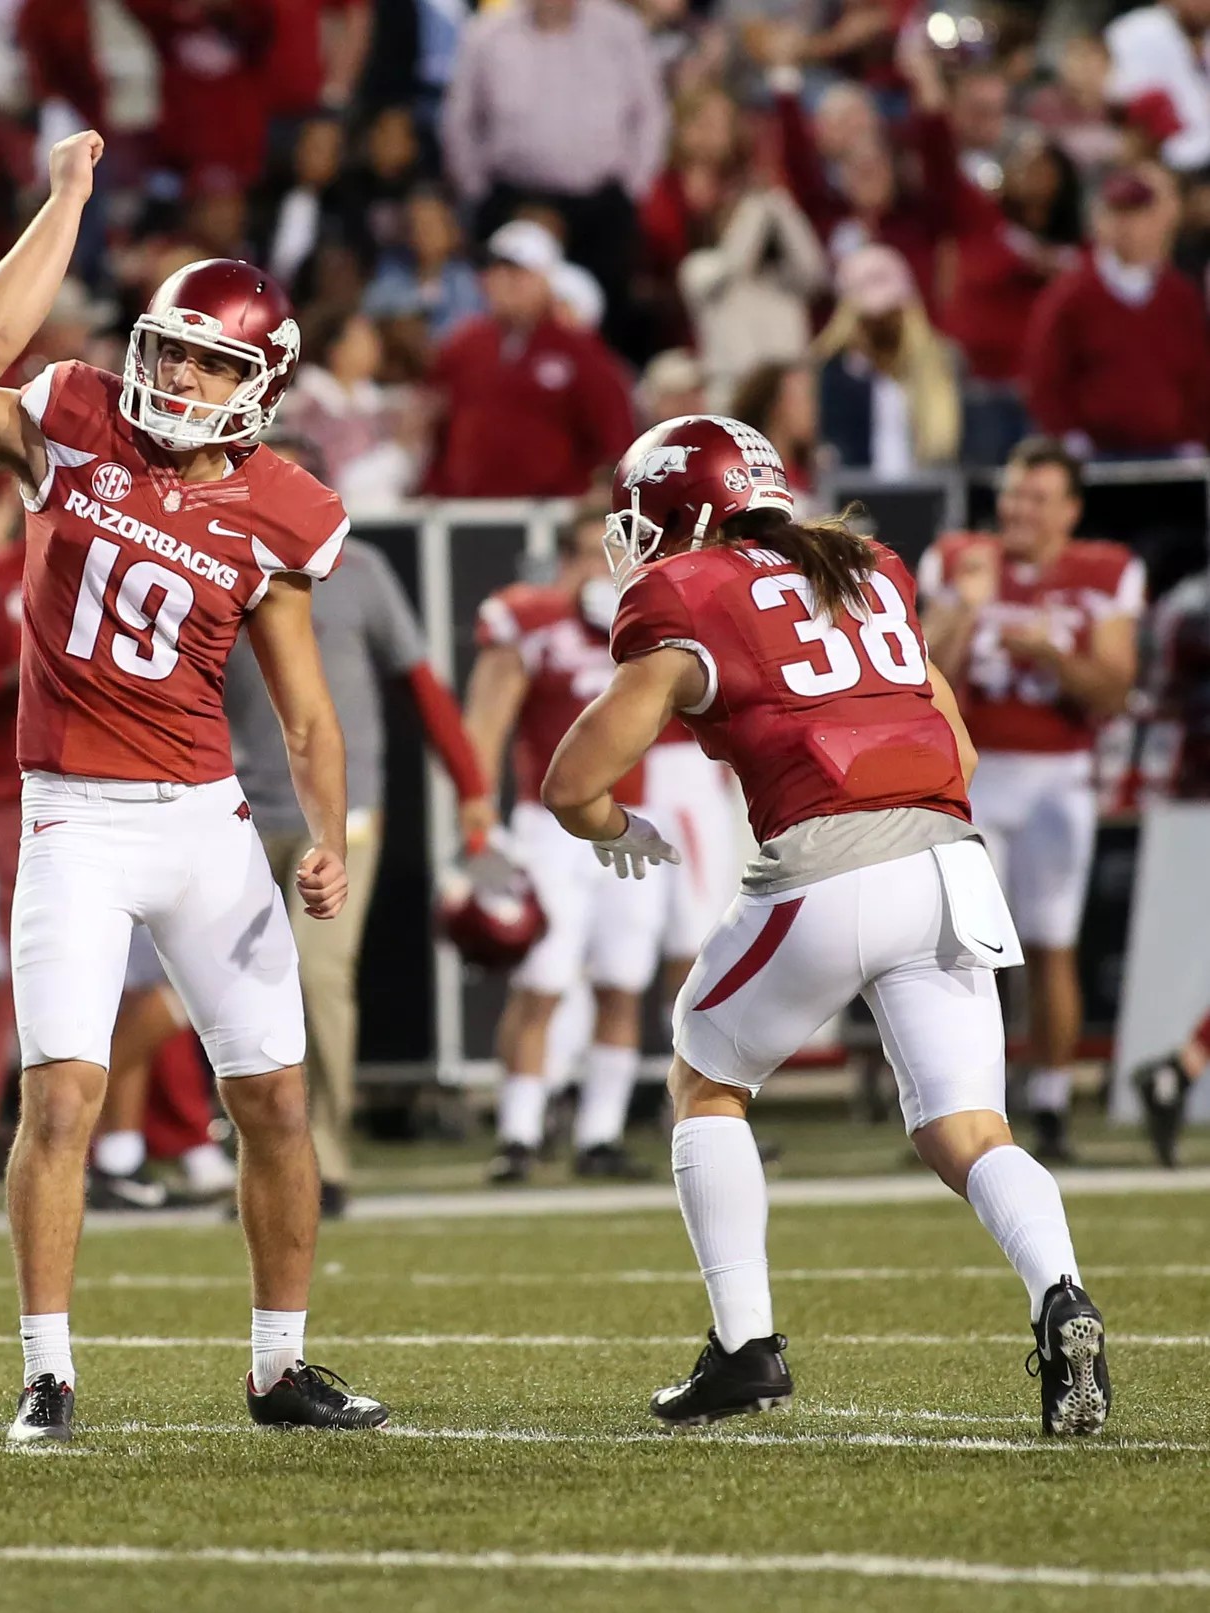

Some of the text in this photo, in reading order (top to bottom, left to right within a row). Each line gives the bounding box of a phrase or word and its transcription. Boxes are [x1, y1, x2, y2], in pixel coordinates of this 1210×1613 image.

[63, 488, 239, 591] RAZORBACKS
[94, 464, 130, 499] SEC
[65, 535, 195, 681] 19
[751, 568, 927, 698] 38
